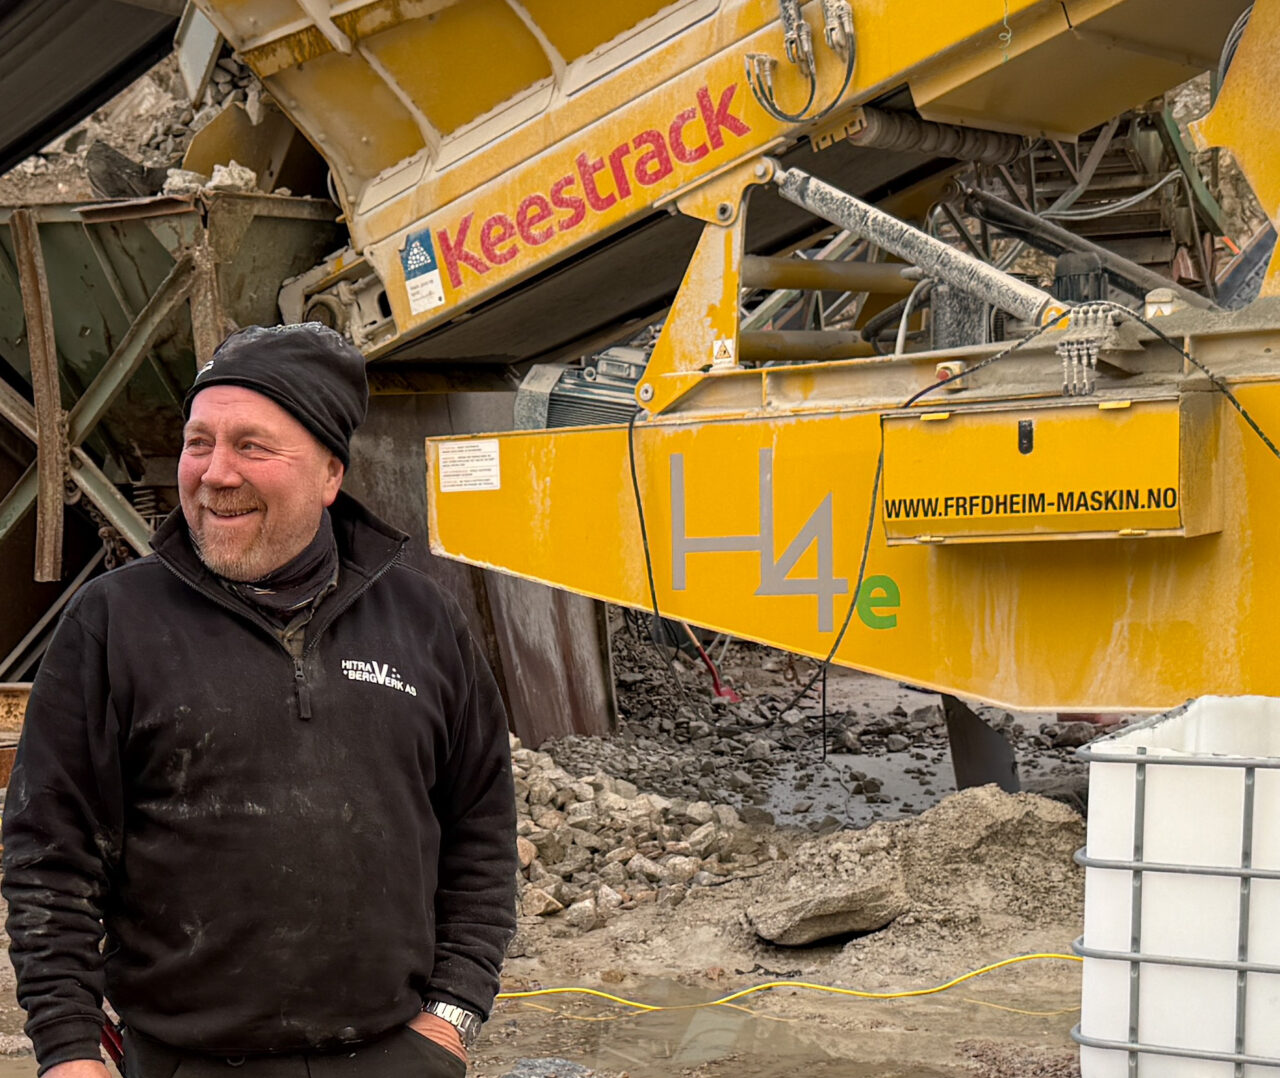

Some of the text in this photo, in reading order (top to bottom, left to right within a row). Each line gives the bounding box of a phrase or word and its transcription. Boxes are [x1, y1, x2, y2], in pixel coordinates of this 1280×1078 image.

[435, 82, 752, 290] Keestrack
[341, 659, 373, 672] HITRA
[347, 660, 417, 697] BERGVERK AS
